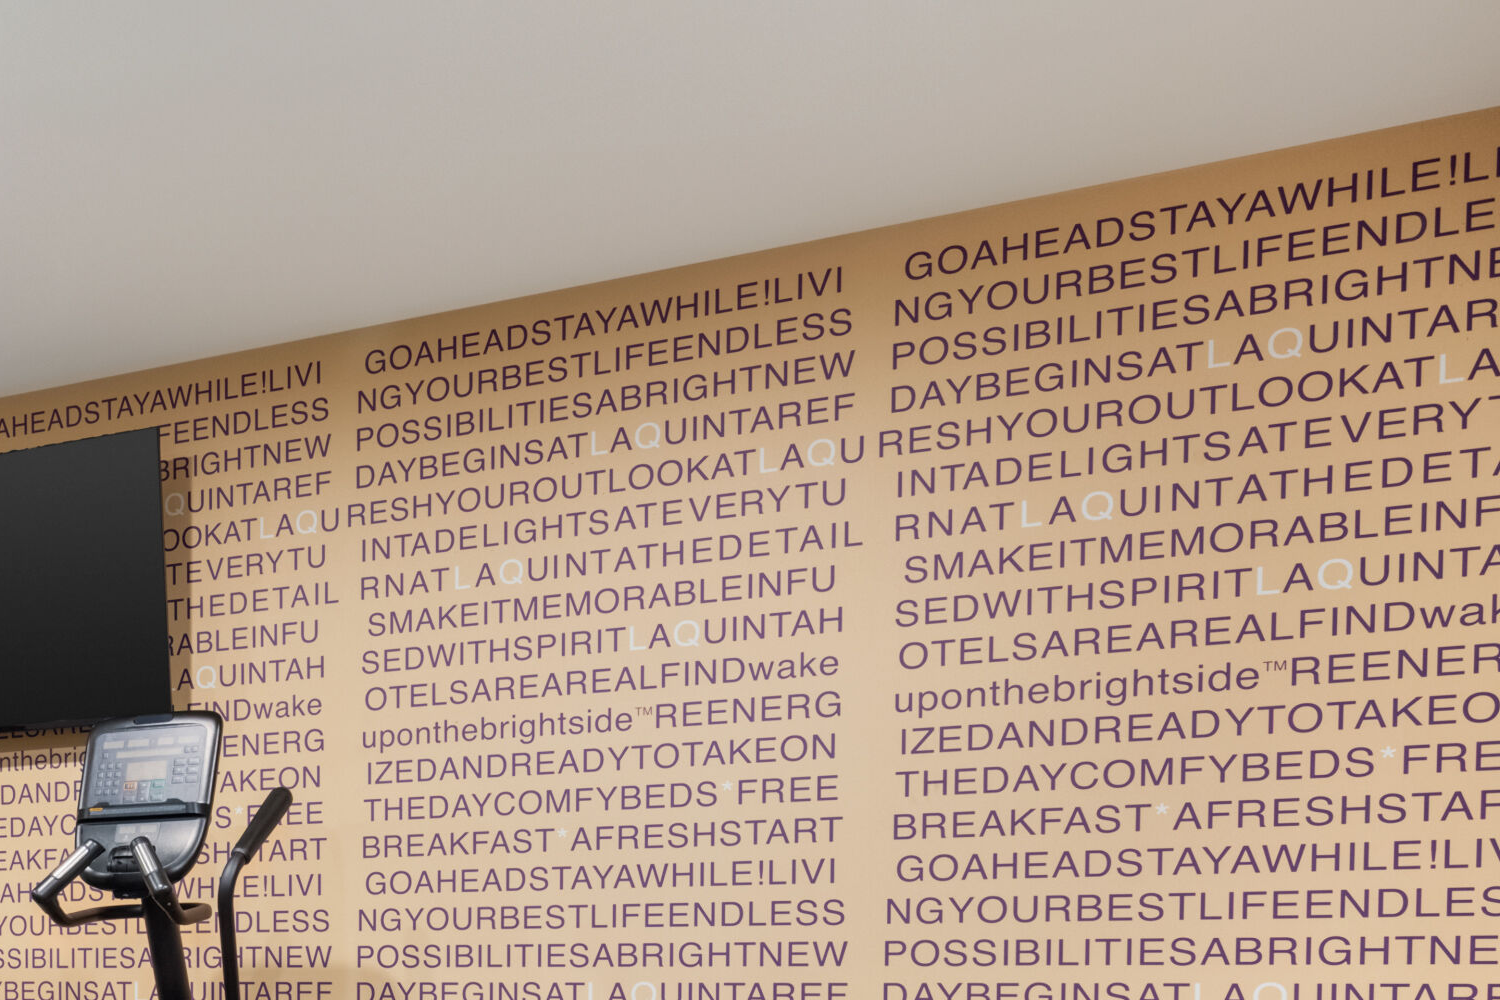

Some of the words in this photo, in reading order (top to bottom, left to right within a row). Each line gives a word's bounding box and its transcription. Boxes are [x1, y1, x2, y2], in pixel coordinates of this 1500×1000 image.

[364, 266, 842, 375] GOAHEADSTAYAWHILE!LIVI
[356, 350, 855, 451] POSSIBILITIESABRIGHTNEW
[358, 308, 852, 414] NGYOURBESTLIFEENDLESS
[356, 392, 855, 489] DAYBEGINSATLAQUINTAREF
[347, 435, 865, 528] RESHYOUROUTLOOKATLAQU
[361, 477, 846, 562] INTADELIGHTSATEVERYTU
[894, 446, 1500, 542] RNATLAQUINTATHEDET
[360, 520, 863, 600] RNATLAQUINTATHEDETAIL
[361, 606, 842, 674] SEDWITHSPIRITLAQUINTAH
[368, 564, 835, 637] SMAKEITMEMORABLEINFU
[364, 651, 839, 711] OTELSAREAREALFINDwake
[367, 733, 836, 785] IZEDANDREADYTOTAKEON
[358, 899, 845, 931] NGYOURBESTLIFEENDLESS
[365, 858, 835, 895] GOAHEADSTAYAWHILE!LIVI
[356, 941, 849, 969] POSSIBILITIESABRIGHTNEW
